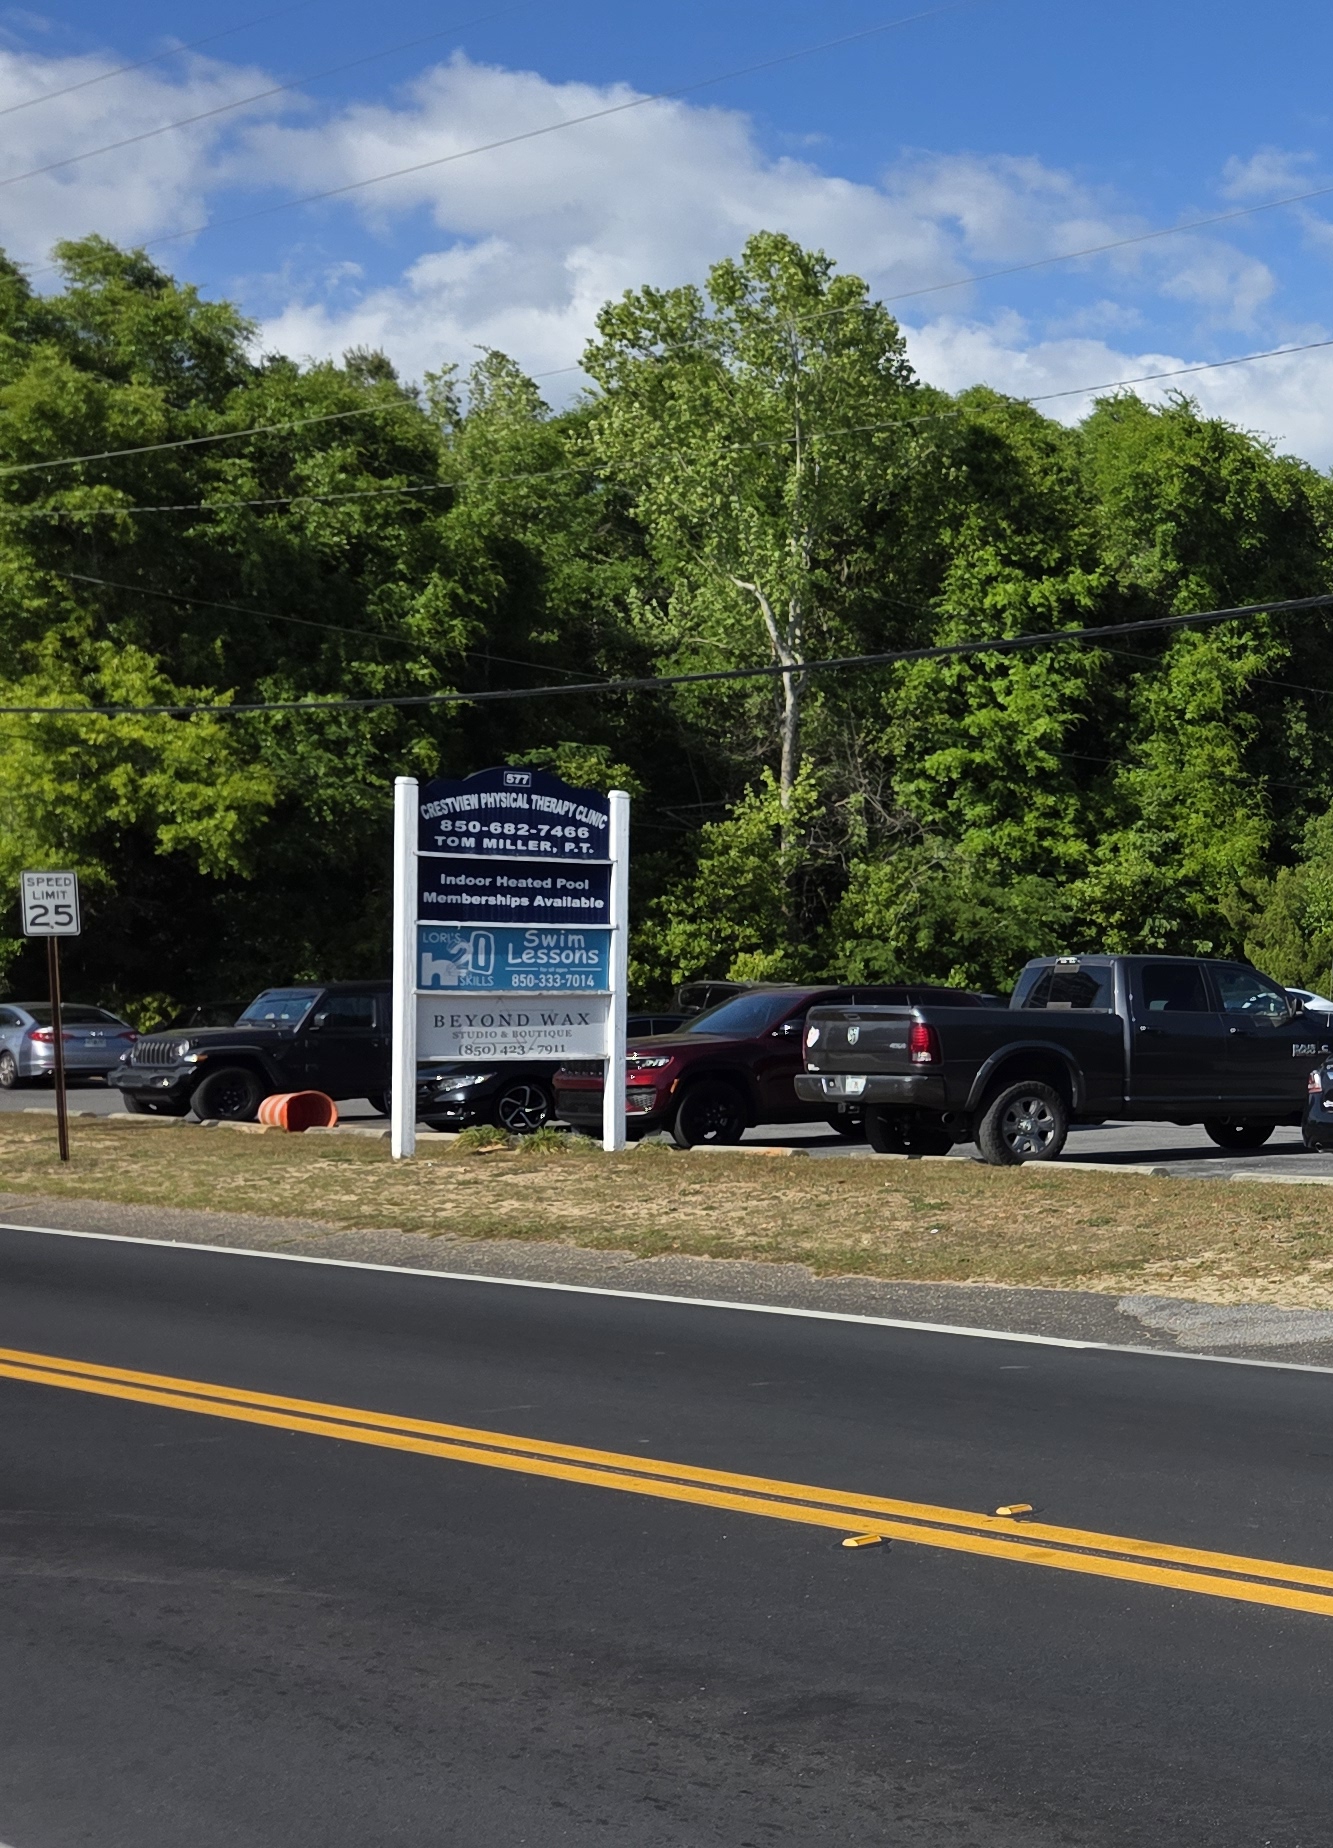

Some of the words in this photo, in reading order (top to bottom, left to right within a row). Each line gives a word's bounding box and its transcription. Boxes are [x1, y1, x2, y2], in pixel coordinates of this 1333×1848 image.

[506, 774, 529, 784] 577
[420, 794, 479, 820] CRESTVIEW
[480, 792, 530, 809] PHYSICAL
[531, 794, 576, 817] THERAPY
[575, 805, 608, 830] CLINIC
[440, 819, 589, 838] 850-682-7466
[434, 836, 475, 848] TOM
[483, 838, 557, 853] MILLER,
[564, 842, 594, 853] P.T.
[27, 877, 72, 887] SPEED
[440, 874, 492, 886] Indoor
[496, 876, 552, 888] Heated
[556, 878, 589, 890] Pool
[32, 890, 67, 900] LIMIT
[423, 892, 529, 908] Memberships
[533, 895, 604, 908] Available
[29, 904, 73, 926] 25
[422, 932, 461, 944] LORI'S
[523, 930, 585, 948] Swim
[508, 943, 599, 964] Lessons
[459, 975, 494, 987] SKILLS
[511, 974, 594, 987] 850-333-7014
[434, 1013, 530, 1028] BEYOND
[541, 1013, 591, 1026] WAX
[452, 1030, 498, 1040] STUDIO
[501, 1031, 509, 1039] &
[512, 1029, 573, 1039] BOUTIQUE
[458, 1043, 497, 1057] (850)
[537, 1044, 566, 1055] 7911
